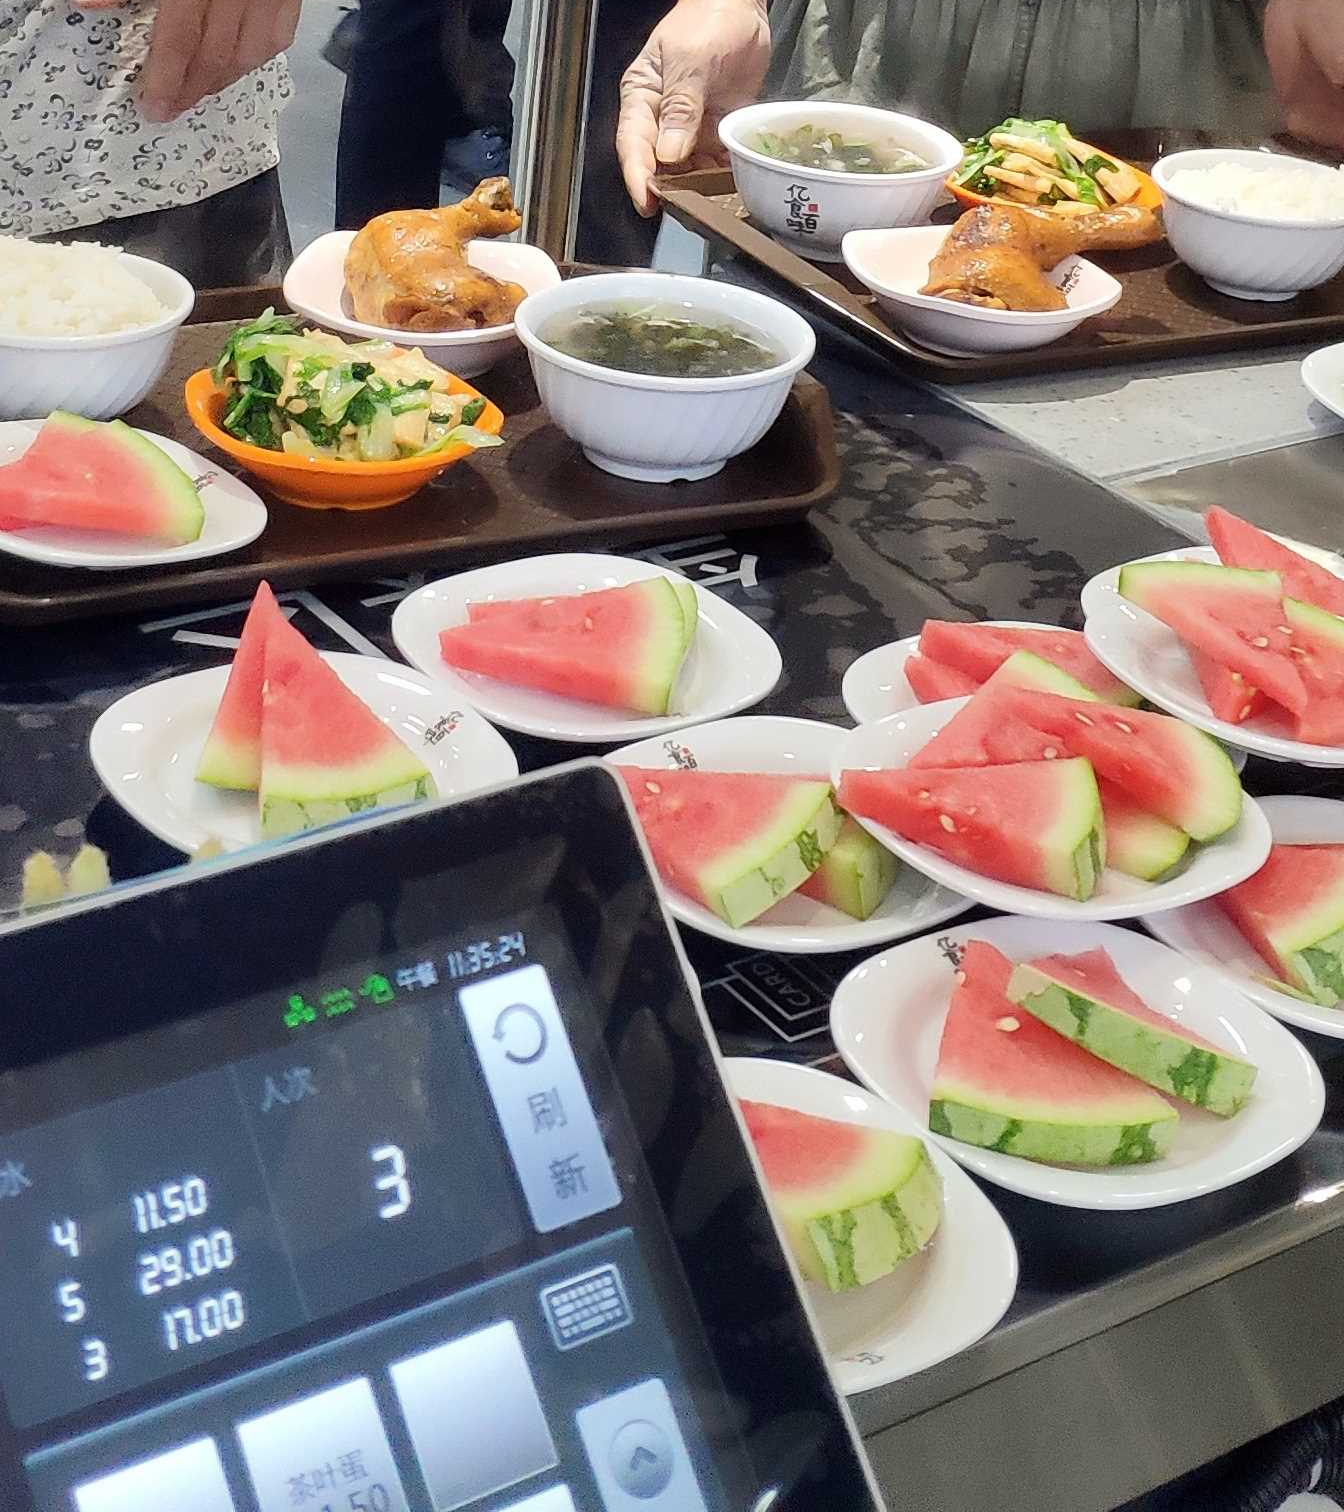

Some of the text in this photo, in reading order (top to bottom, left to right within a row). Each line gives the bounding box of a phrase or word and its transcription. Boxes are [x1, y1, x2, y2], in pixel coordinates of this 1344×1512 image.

[753, 962, 811, 1006] CARD
[371, 1144, 411, 1220] 3
[527, 1086, 589, 1201] 刷新
[52, 1175, 208, 1257] 4 11.50
[58, 1229, 235, 1322] 5 29.00
[83, 1289, 245, 1381] 3 17.00
[287, 1449, 369, 1506] 茶叶蛋
